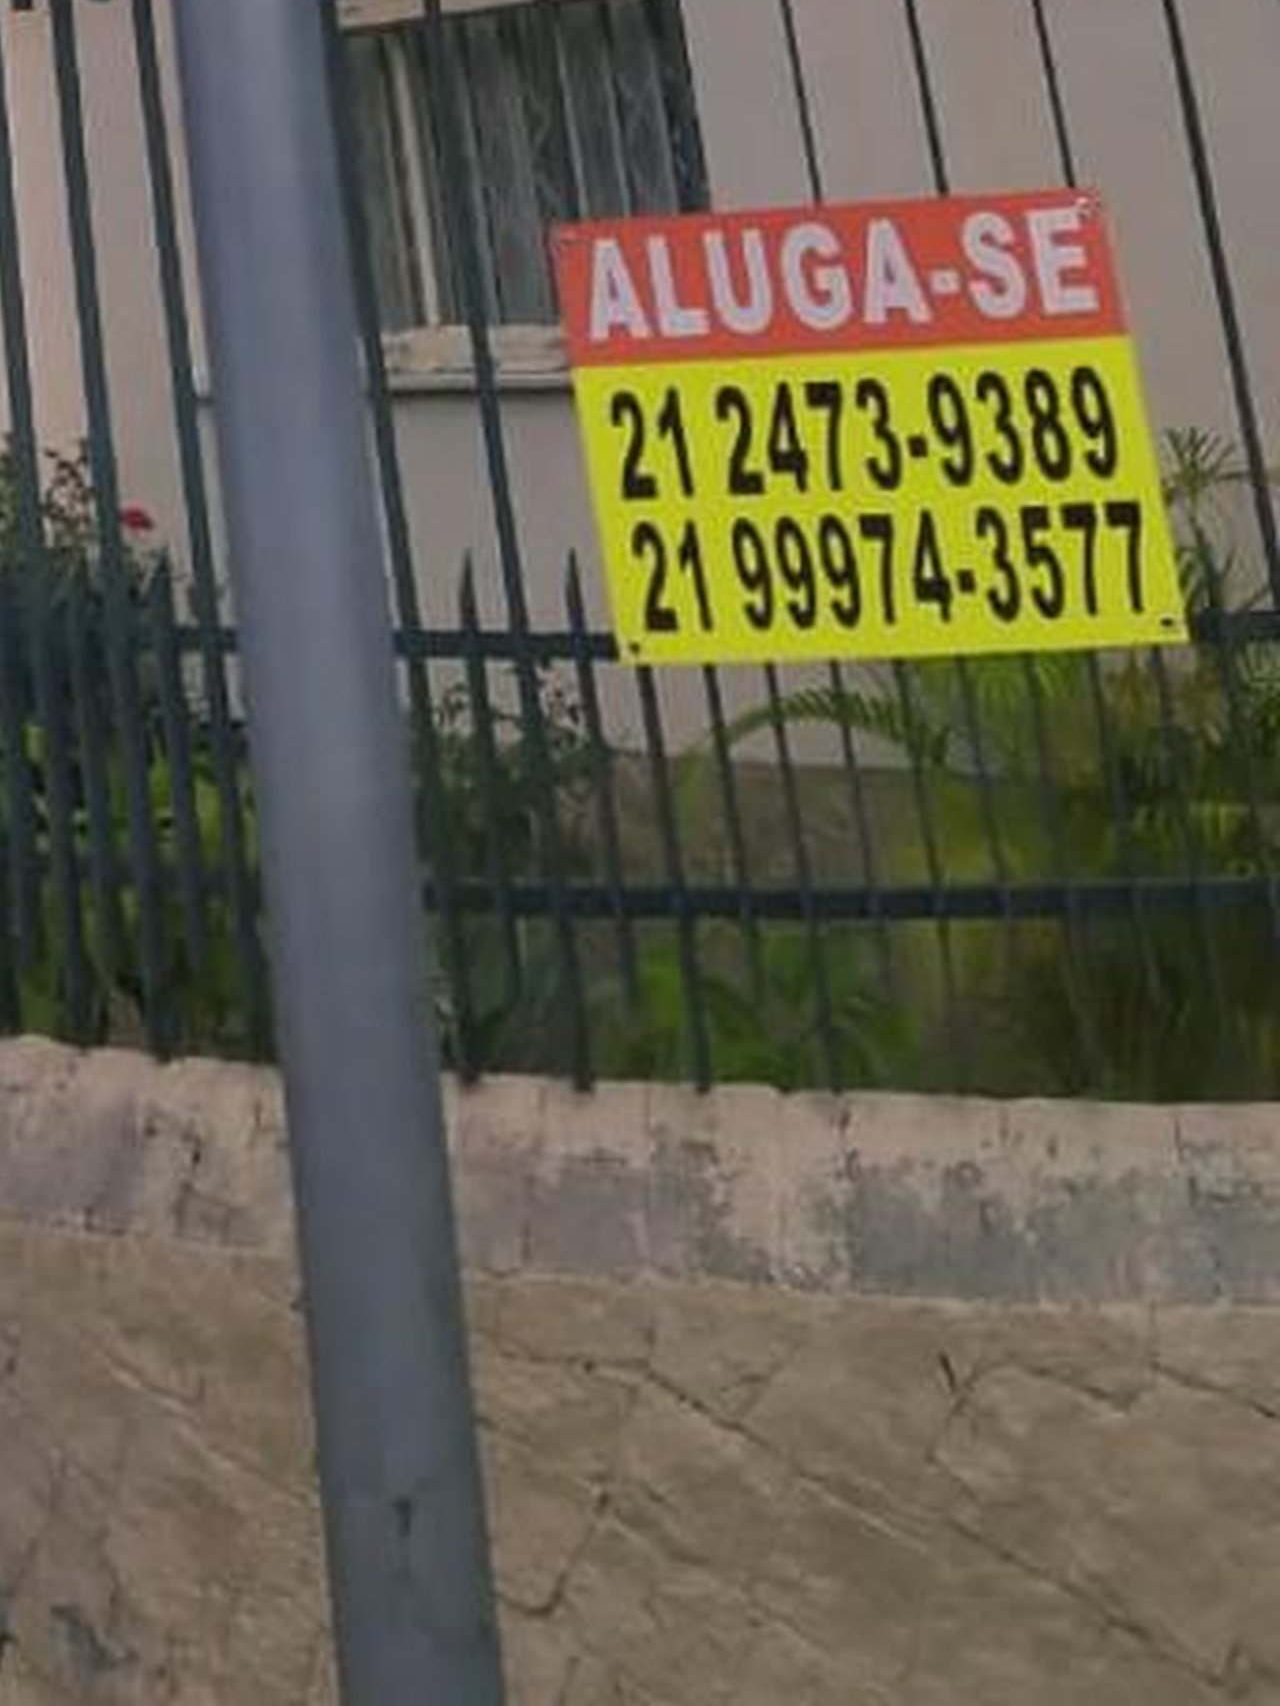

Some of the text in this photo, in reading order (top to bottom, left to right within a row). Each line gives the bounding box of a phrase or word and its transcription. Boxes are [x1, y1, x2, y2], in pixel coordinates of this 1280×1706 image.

[591, 208, 1098, 342] ALUGA-SE
[610, 366, 1118, 500] 21 2473-9389
[632, 502, 1143, 633] 21 99974-3577
